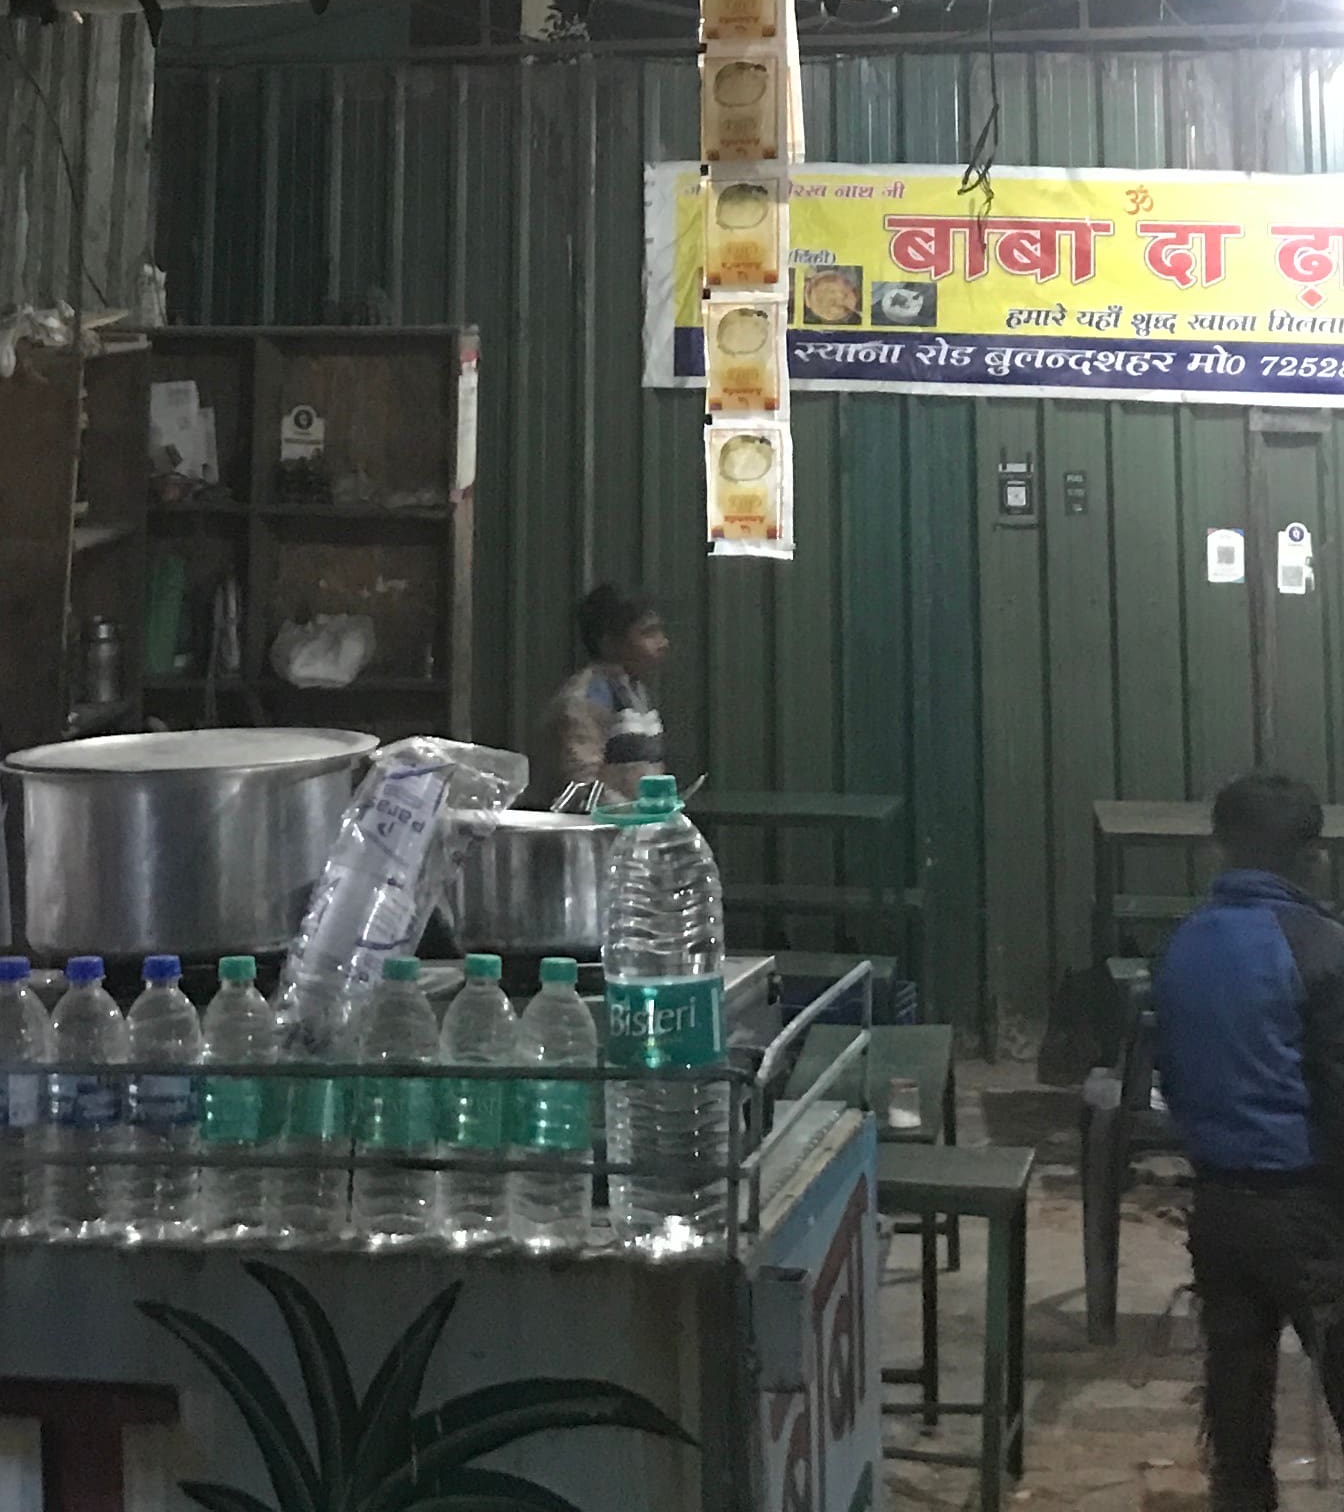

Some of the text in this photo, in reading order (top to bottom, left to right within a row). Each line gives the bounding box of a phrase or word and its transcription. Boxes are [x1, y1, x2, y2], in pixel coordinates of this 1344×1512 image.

[834, 184, 873, 198] नाथ
[881, 182, 904, 198] जी
[883, 214, 1114, 285] बाबा
[1136, 221, 1245, 289] दा
[1005, 303, 1068, 330] हमारे
[1076, 304, 1123, 332] यहाँ
[1187, 313, 1256, 332] खाना
[1268, 308, 1344, 334] मिलता
[794, 340, 903, 365] स्याना
[915, 337, 973, 368] रोड
[984, 345, 1175, 378] बुलन्दशहर
[609, 996, 696, 1036] Biseri
